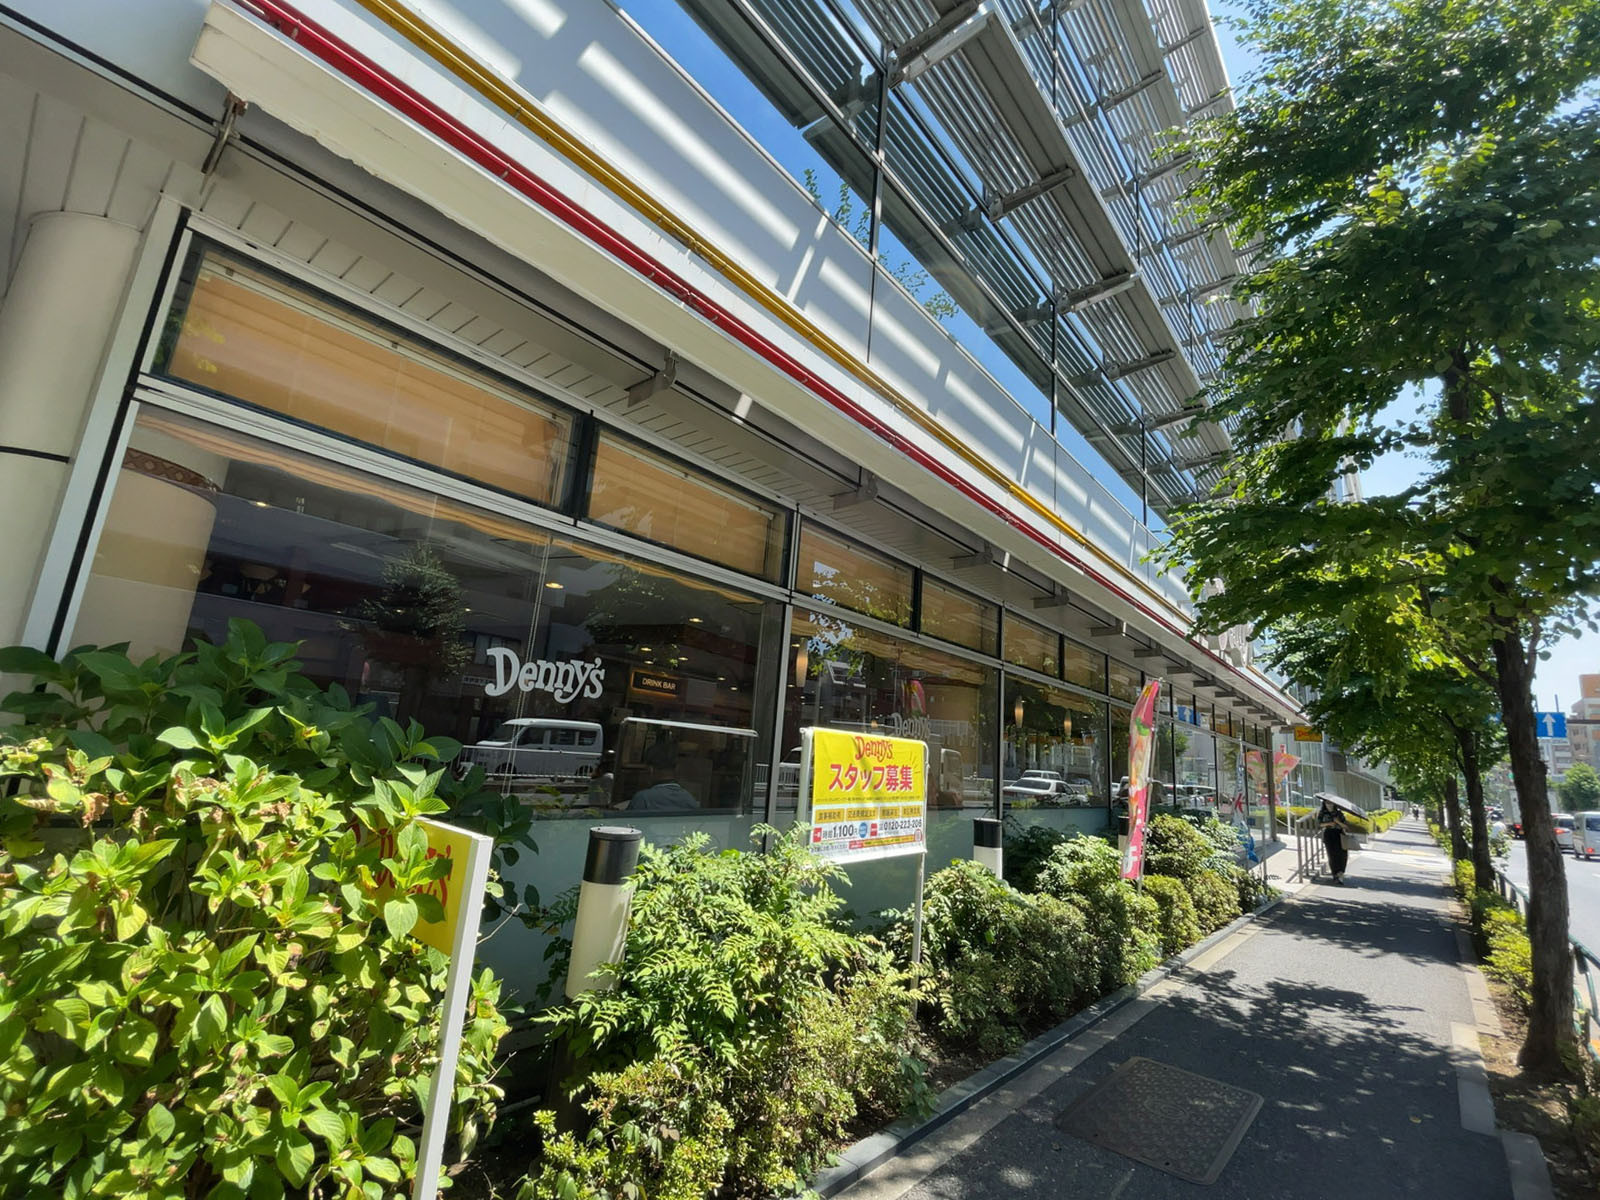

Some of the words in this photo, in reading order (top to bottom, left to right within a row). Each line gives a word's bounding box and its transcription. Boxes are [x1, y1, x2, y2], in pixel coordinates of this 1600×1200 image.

[485, 647, 605, 703] Denny's
[642, 678, 662, 688] DRINK
[663, 681, 676, 690] BAR
[855, 736, 893, 762] Denny's
[828, 763, 913, 792] スタッフ募集
